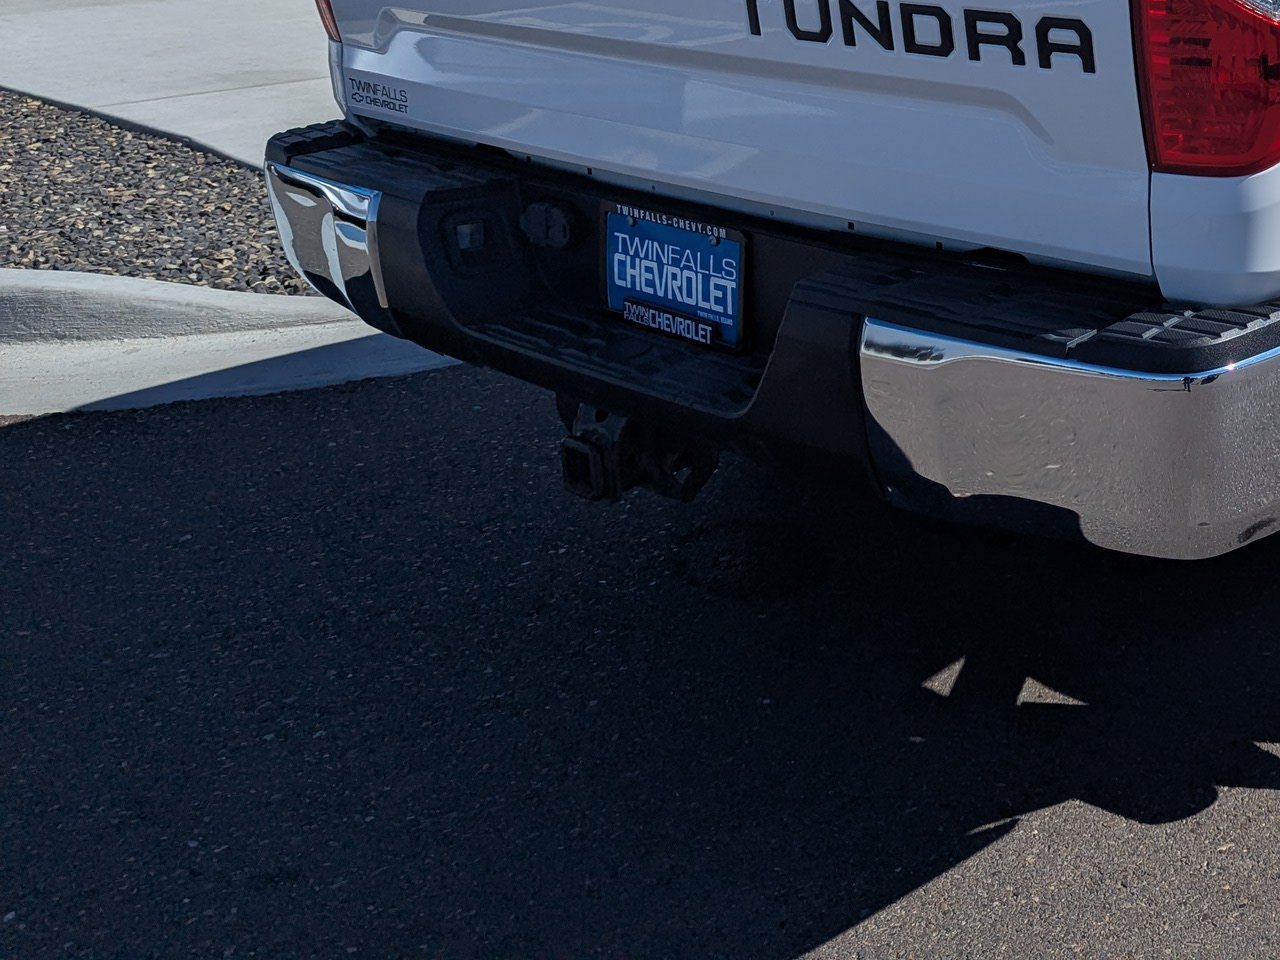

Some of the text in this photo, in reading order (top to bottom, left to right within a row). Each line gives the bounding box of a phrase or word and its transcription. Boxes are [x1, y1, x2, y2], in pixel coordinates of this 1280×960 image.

[349, 77, 408, 103] TWINFALLS
[365, 95, 409, 114] CHEVROLET
[616, 204, 727, 239] TWINFALLS-CHEVY.COM
[614, 232, 737, 280] TWINFALLS
[614, 252, 737, 315] CHEVROLET
[624, 302, 650, 318] TWIN
[624, 312, 650, 326] FALLS
[649, 309, 713, 345] CHEVROLET
